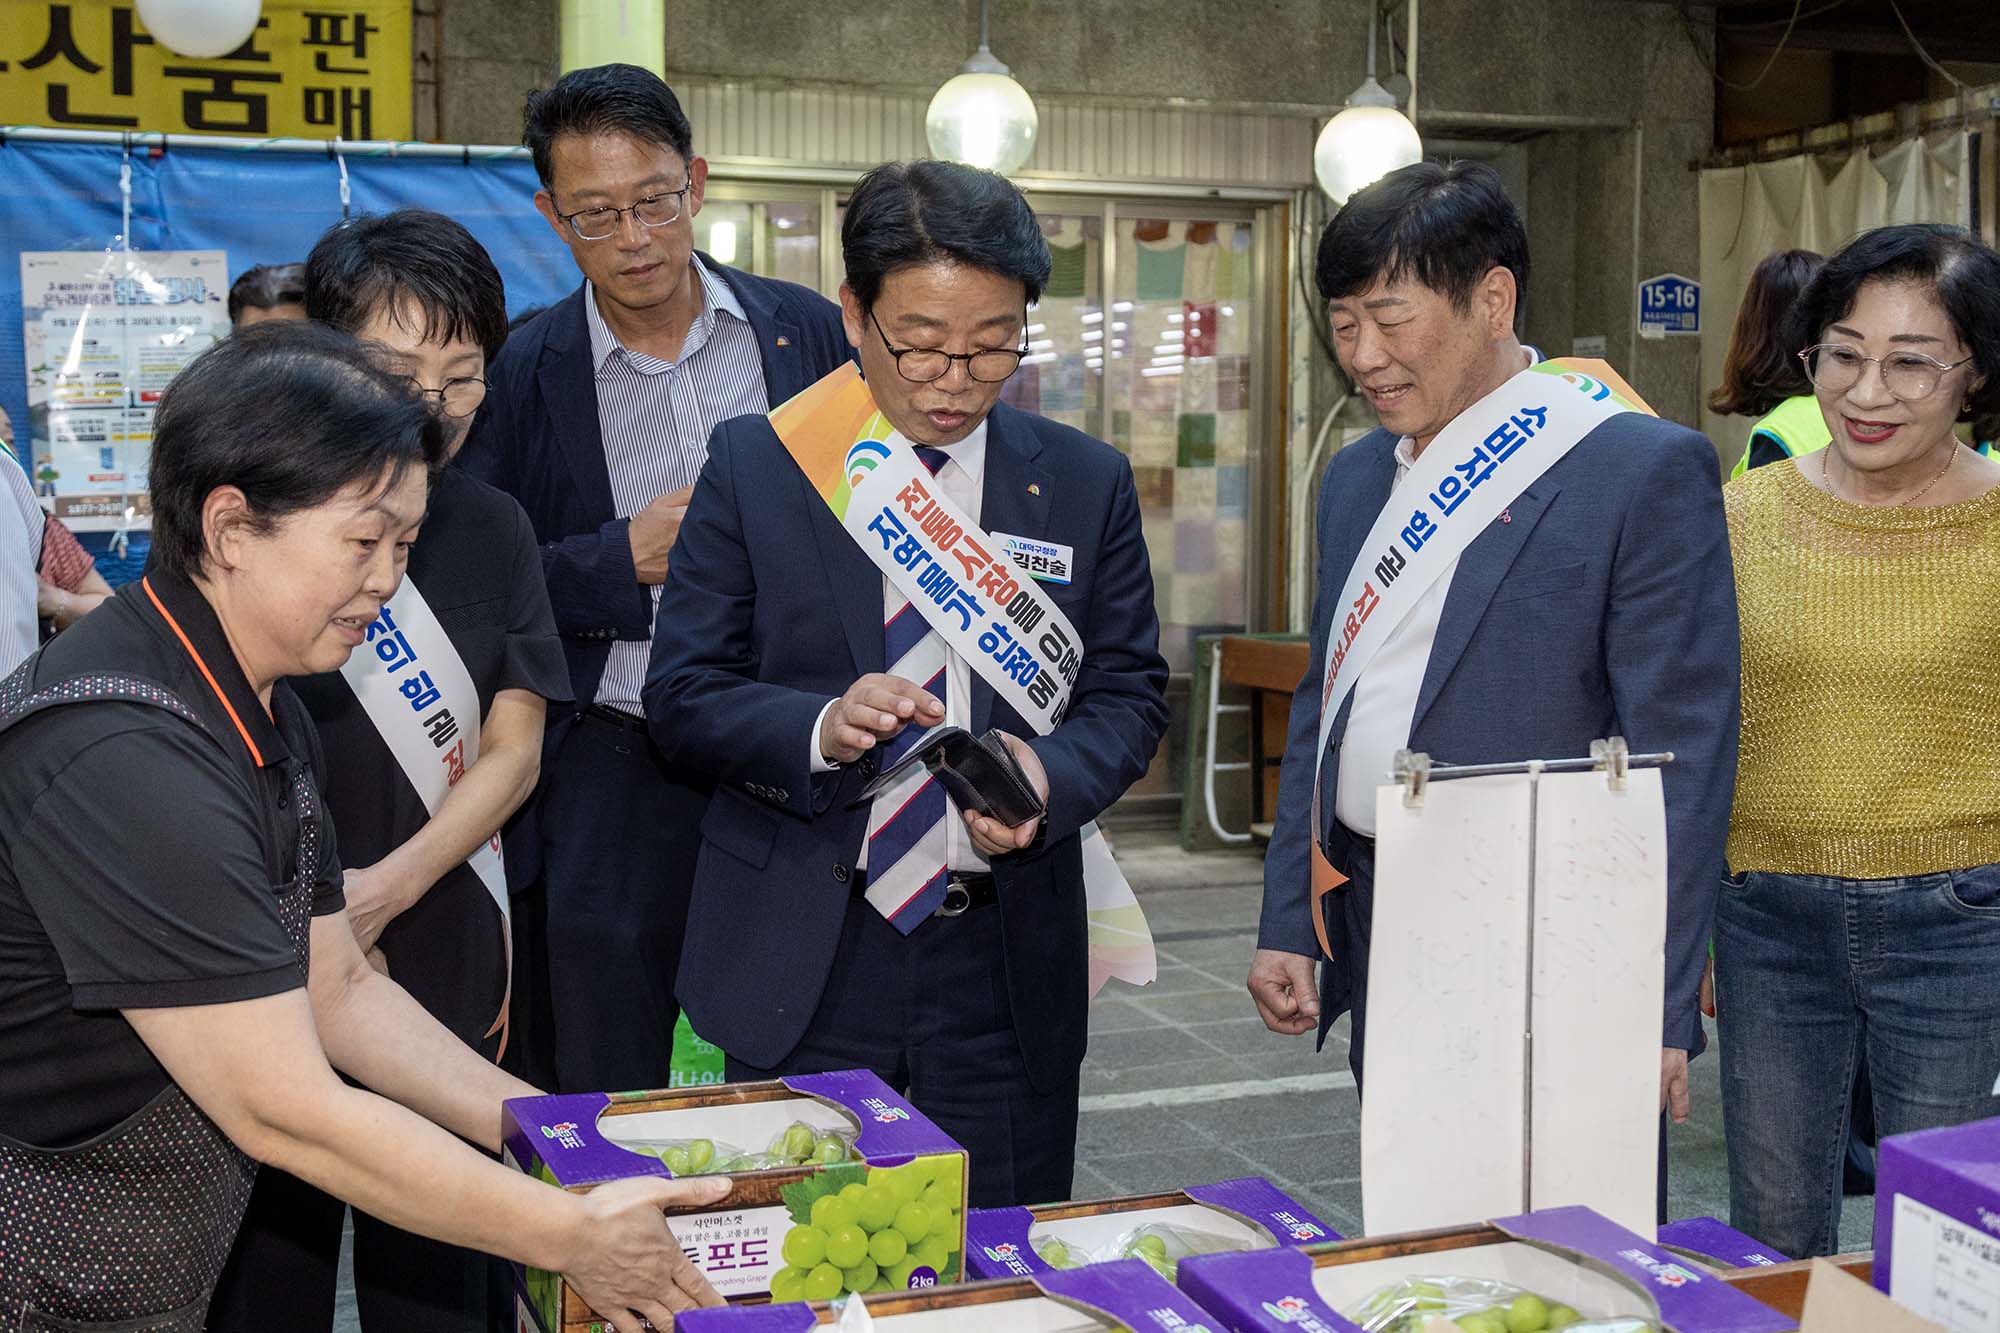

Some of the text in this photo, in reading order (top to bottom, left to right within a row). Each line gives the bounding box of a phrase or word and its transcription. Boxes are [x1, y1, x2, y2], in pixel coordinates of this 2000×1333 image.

[0, 4, 283, 134] 산품
[1645, 284, 1696, 309] 15-16
[1429, 405, 1548, 517] 소비자의
[1018, 541, 1058, 557] 대덕구청장
[1400, 510, 1438, 553] 힘
[896, 477, 1046, 634] 전통시장을
[1012, 551, 1067, 577] 김찬술
[1374, 545, 1407, 588] 곧
[867, 506, 1059, 710] 지역물가 안정에
[399, 670, 442, 713] 힘
[422, 707, 460, 749] 곧
[706, 1240, 768, 1272] 포도
[911, 1275, 935, 1289] 2kg
